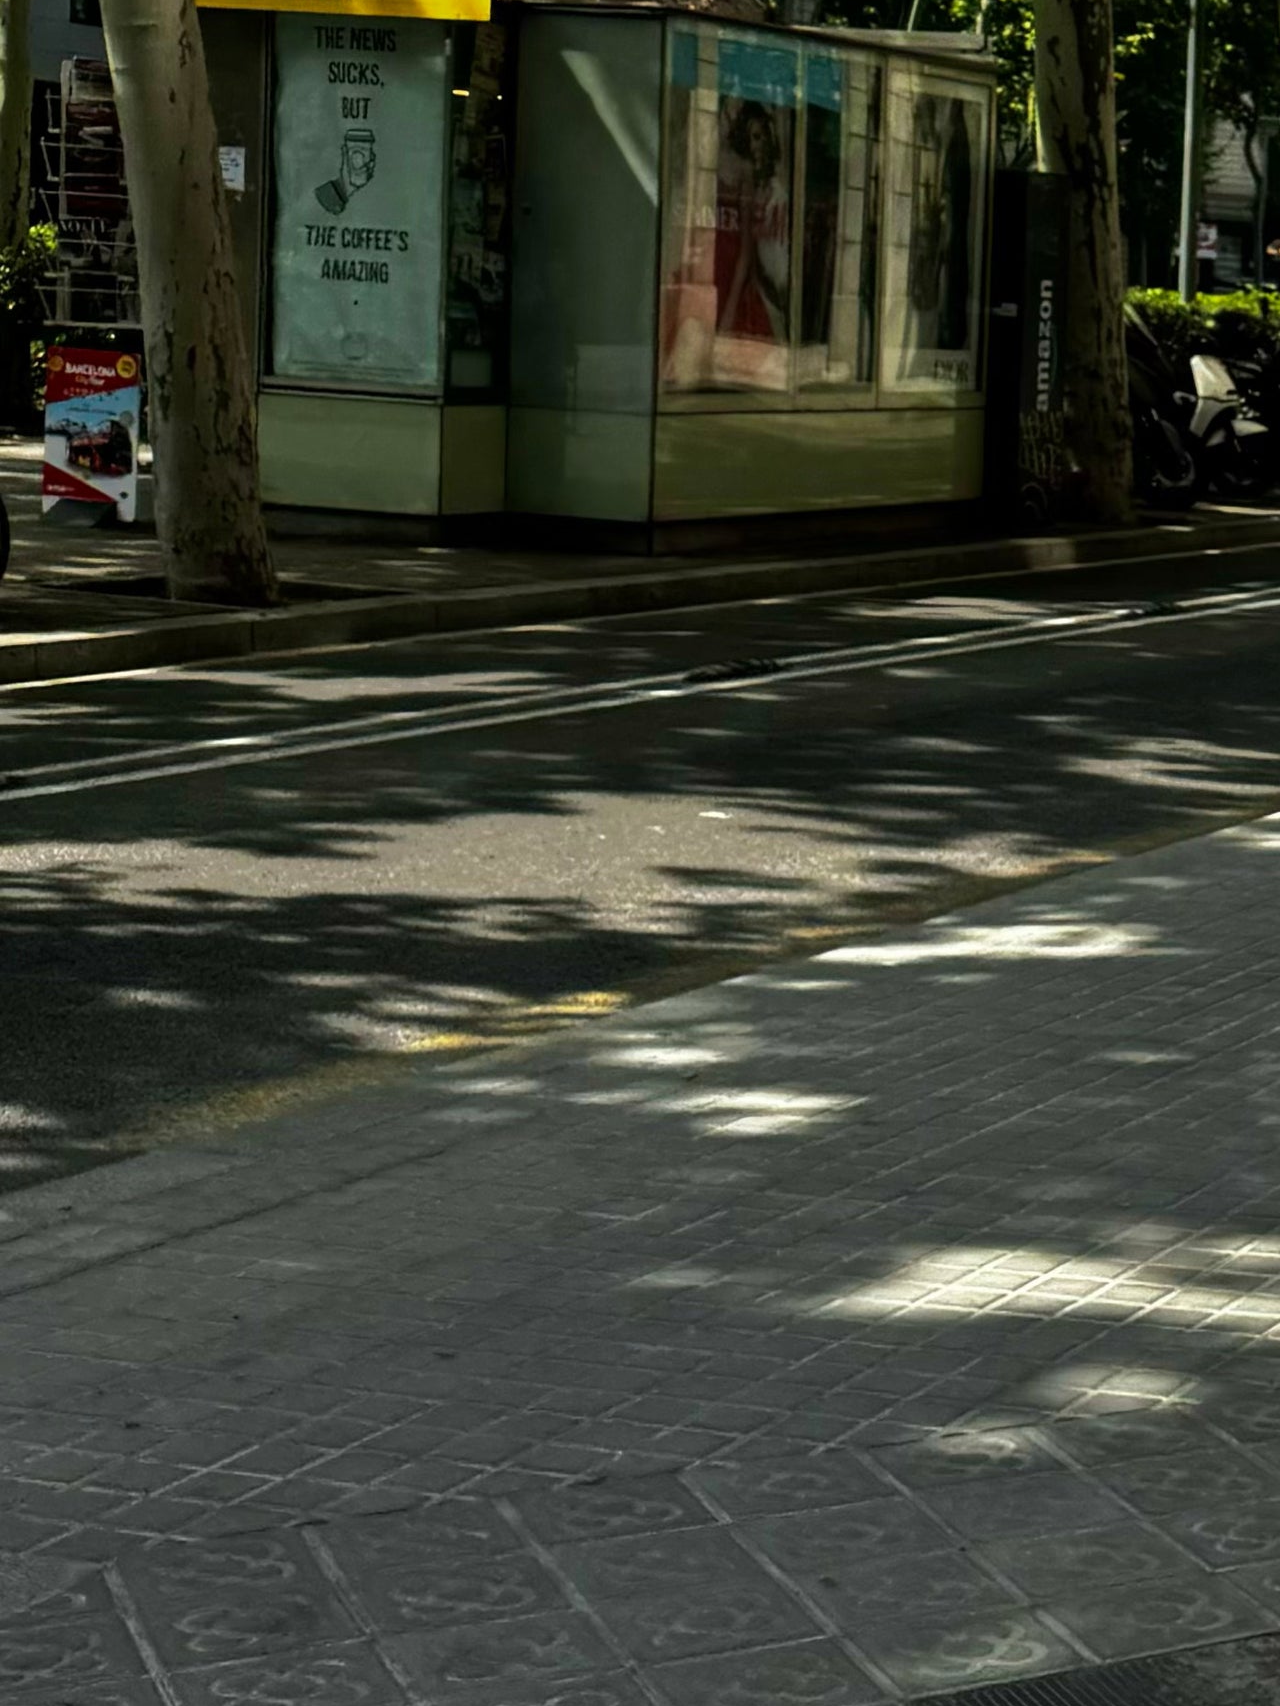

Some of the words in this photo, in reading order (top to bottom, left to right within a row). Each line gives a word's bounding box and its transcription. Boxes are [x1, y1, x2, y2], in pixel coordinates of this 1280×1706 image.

[314, 26, 345, 49] THE
[350, 27, 396, 51] NEWS
[341, 96, 372, 119] BUT
[305, 224, 336, 247] THE
[341, 227, 409, 251] COFFEE'S
[321, 258, 388, 284] AMAZING
[1035, 279, 1055, 412] amazon
[65, 362, 116, 376] BARCELONA
[933, 359, 969, 383] DIOR
